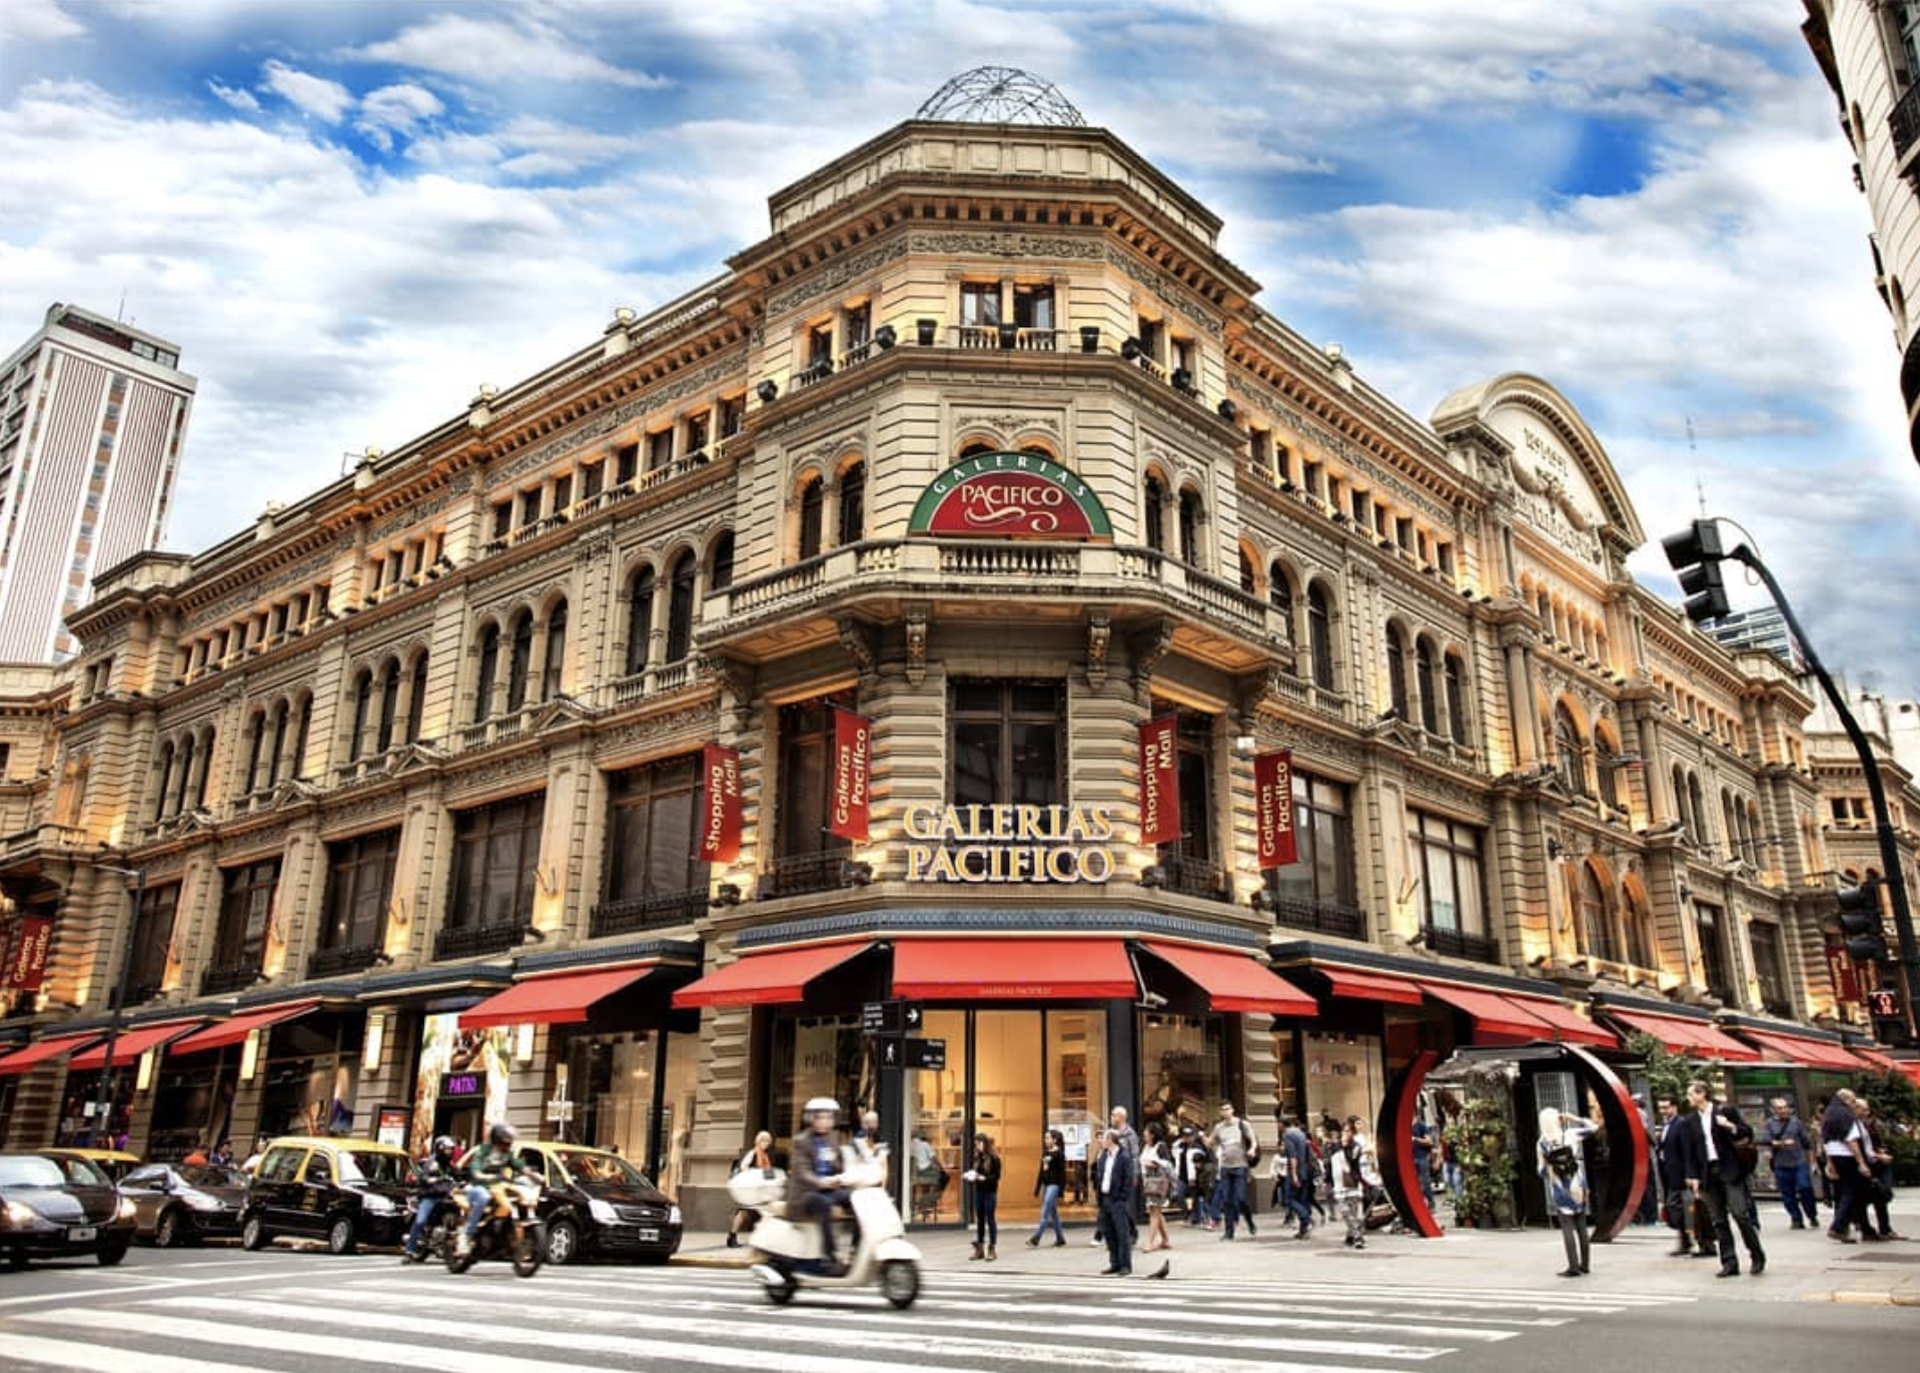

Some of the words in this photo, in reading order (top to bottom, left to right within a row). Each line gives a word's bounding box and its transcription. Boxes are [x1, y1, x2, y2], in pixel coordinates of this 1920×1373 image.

[933, 455, 1088, 497] GALERIAS
[961, 485, 1063, 506] PACIFICO
[851, 728, 867, 806] Pacifico
[1158, 729, 1172, 769] Mall
[723, 759, 739, 797] Mall
[836, 745, 851, 825] Galerias
[1144, 744, 1160, 834] Shopping
[1276, 761, 1290, 833] Pacifico
[705, 765, 726, 852] Shopping
[903, 803, 1113, 840] GALERIAS
[1260, 785, 1276, 857] Galerias
[905, 844, 1115, 883] PACIFICO
